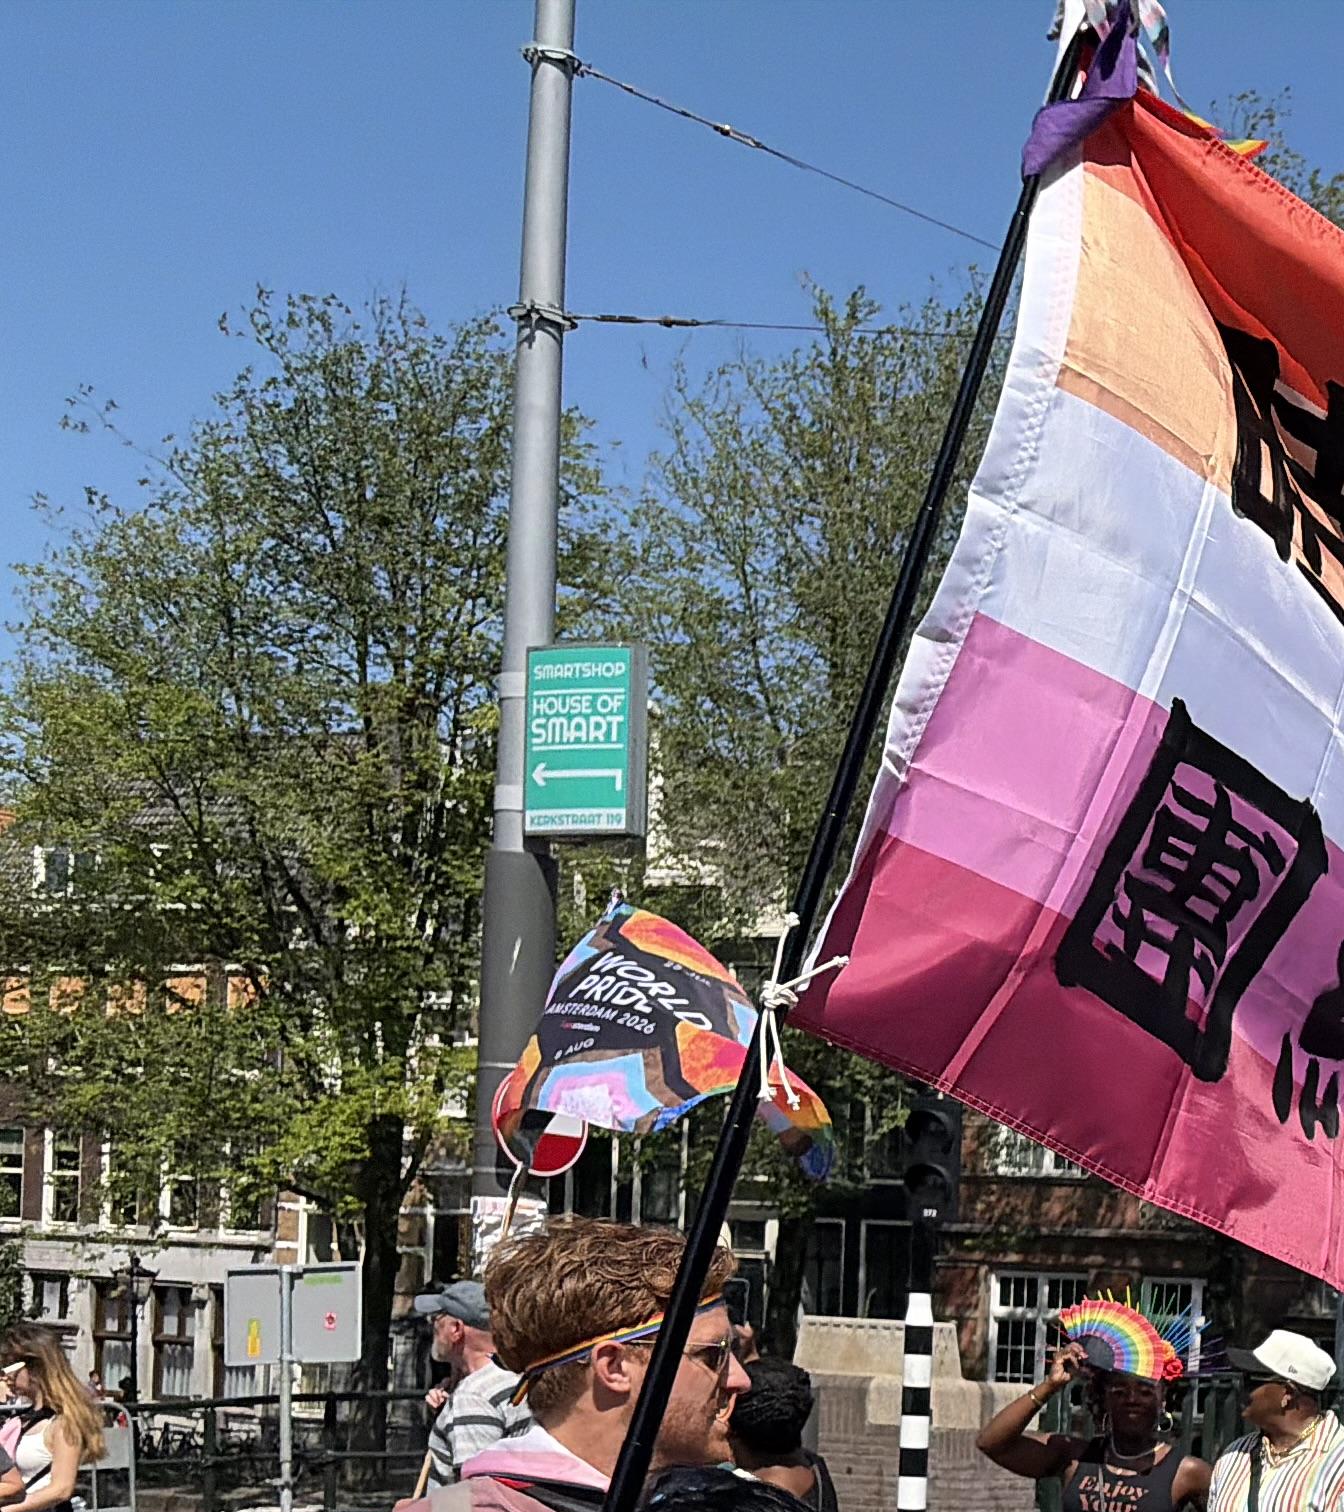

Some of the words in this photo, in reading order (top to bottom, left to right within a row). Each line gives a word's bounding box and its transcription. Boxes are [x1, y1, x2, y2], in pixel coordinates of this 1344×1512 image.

[533, 662, 625, 680] SMARTSHOP
[532, 696, 593, 716] HOUSE
[597, 695, 625, 714] OF
[531, 716, 625, 744] SMART
[530, 813, 603, 827] KERKSTRAAT
[567, 974, 653, 1014] PRIDE
[589, 951, 713, 1032] WORLD
[545, 1002, 619, 1021] AMSTERDAM
[616, 1012, 657, 1034] 2026
[564, 1037, 595, 1056] AUG
[1078, 1475, 1149, 1501] Enjoy
